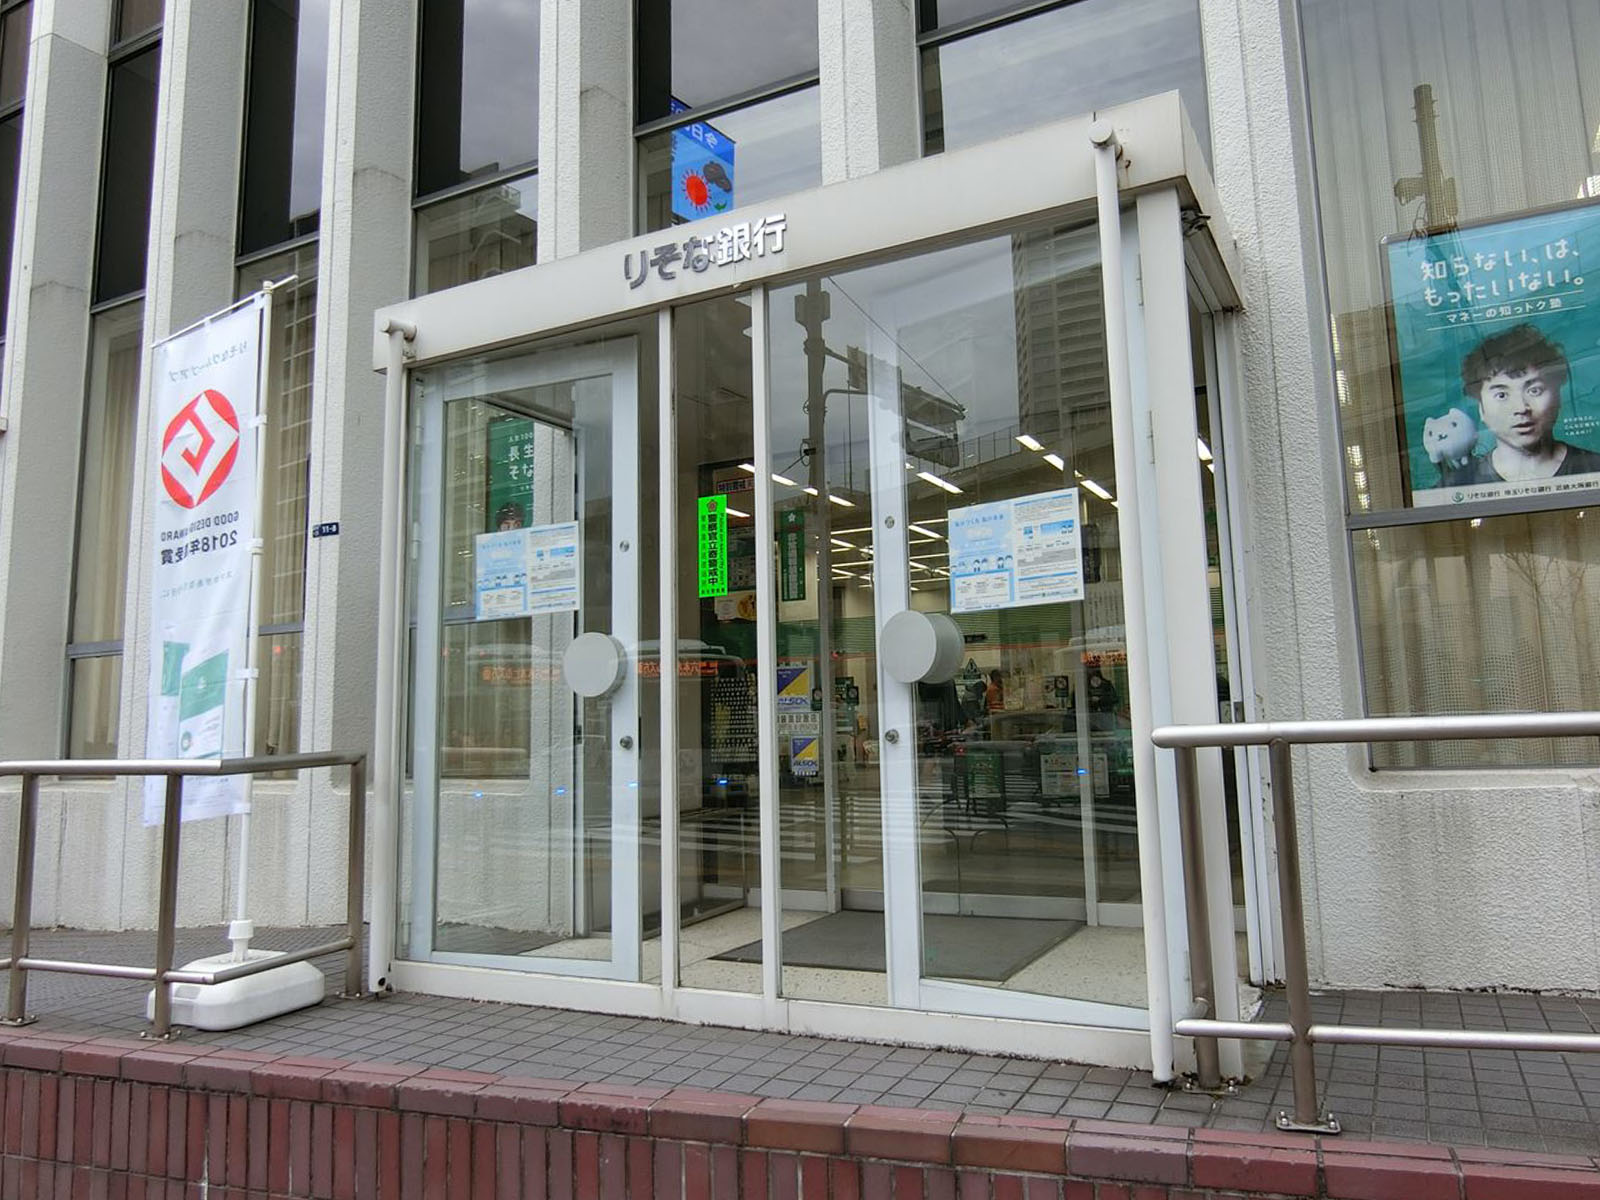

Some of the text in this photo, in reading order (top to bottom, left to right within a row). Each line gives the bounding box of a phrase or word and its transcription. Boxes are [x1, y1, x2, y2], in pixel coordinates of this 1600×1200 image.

[624, 212, 787, 290] りそな銀行
[1420, 238, 1579, 281] 知らない、は、
[1423, 269, 1584, 307] もったいない。
